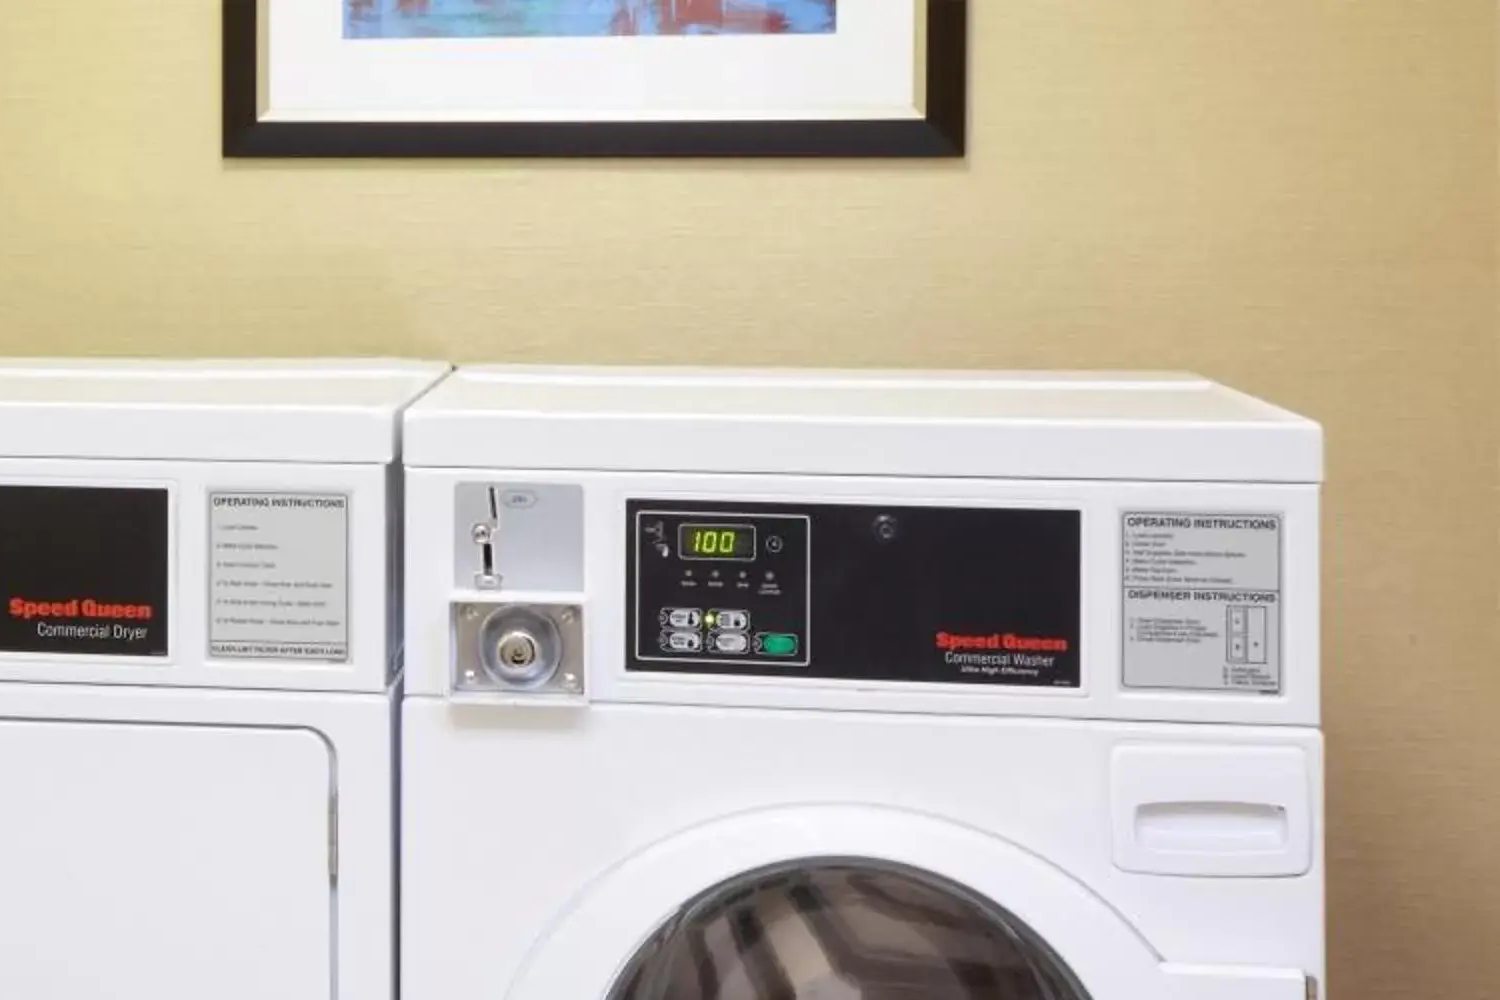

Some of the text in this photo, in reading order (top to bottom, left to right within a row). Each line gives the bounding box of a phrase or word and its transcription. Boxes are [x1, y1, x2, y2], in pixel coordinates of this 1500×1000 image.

[213, 496, 345, 509] OPERATING INSTRUCTIONS
[1127, 516, 1277, 531] OPERATING INSTRUCTIONS
[694, 530, 736, 553] 100
[1128, 589, 1276, 603] DISPENSER INSTRUCTIONS
[10, 597, 153, 619] Speed Queen
[37, 621, 148, 641] Commercial Dryer
[935, 631, 1068, 652] Speed Queen
[945, 652, 1055, 667] Commercial Washer
